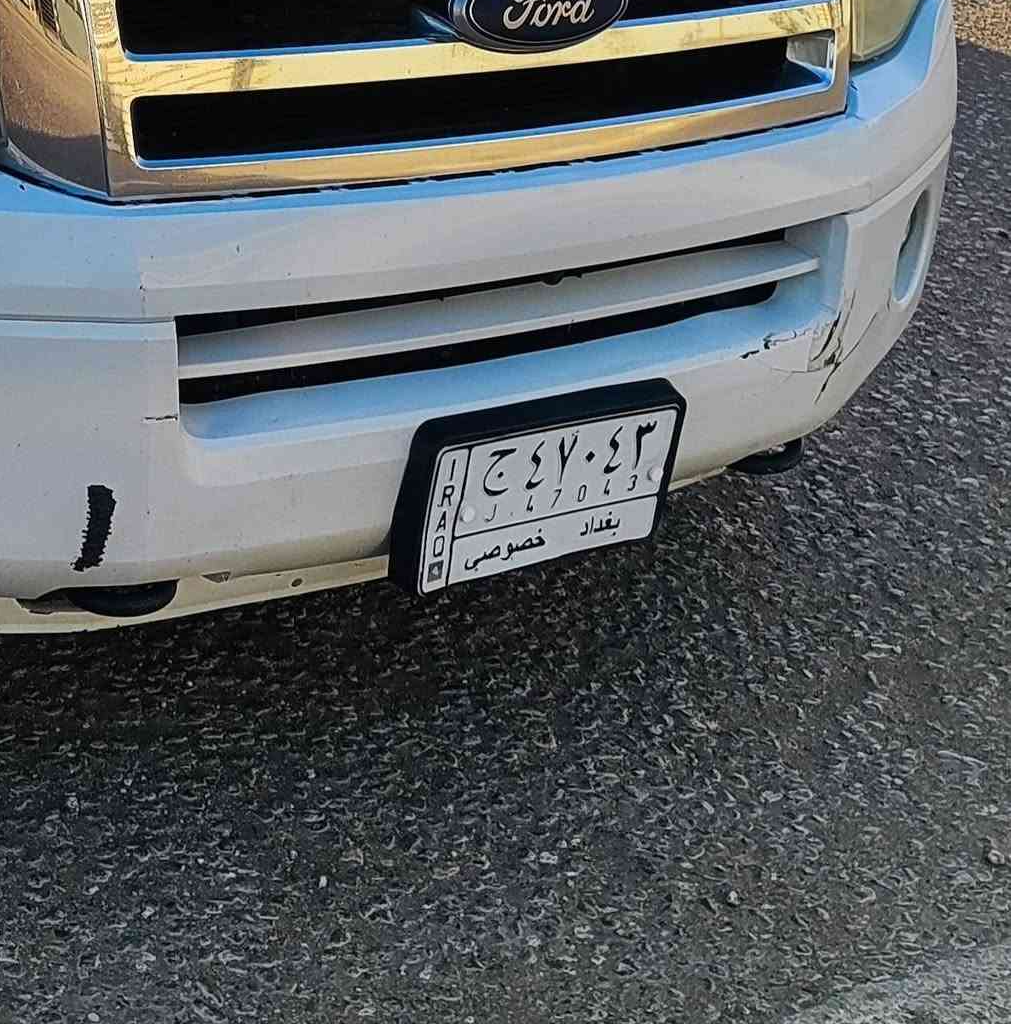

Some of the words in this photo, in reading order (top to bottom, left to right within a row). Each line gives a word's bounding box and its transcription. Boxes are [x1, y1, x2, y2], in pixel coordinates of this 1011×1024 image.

[432, 458, 456, 558] IRAQ
[580, 510, 621, 537] بغداد
[464, 528, 546, 571] خصوصي
